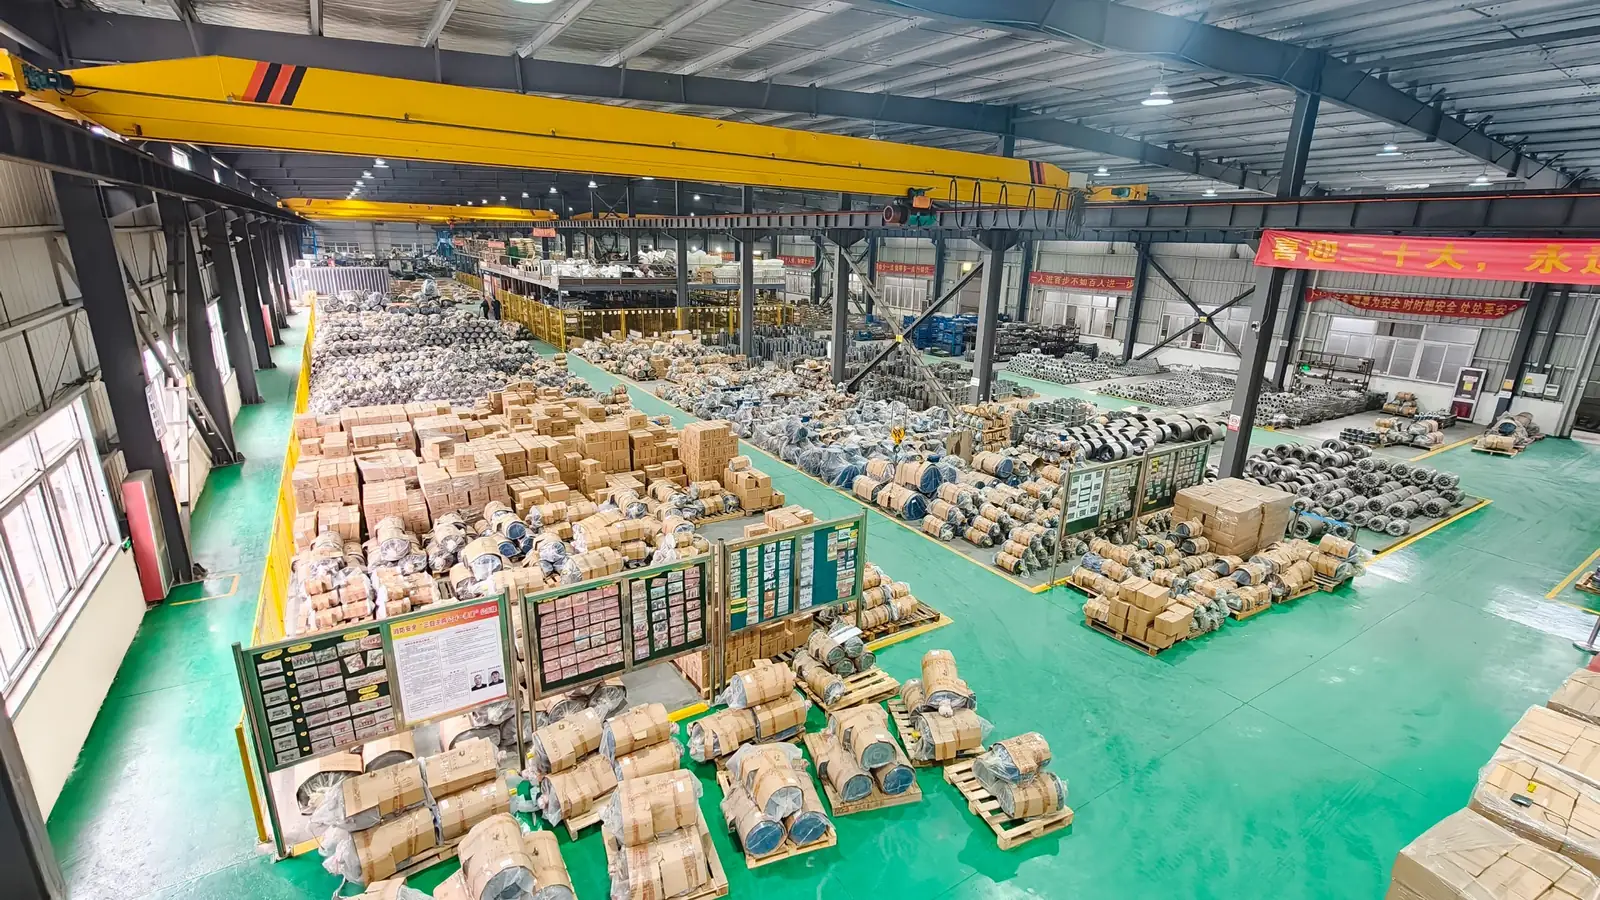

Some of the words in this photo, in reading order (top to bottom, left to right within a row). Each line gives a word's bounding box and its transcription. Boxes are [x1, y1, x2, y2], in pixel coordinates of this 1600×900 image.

[1403, 298, 1457, 314] 时时想安全
